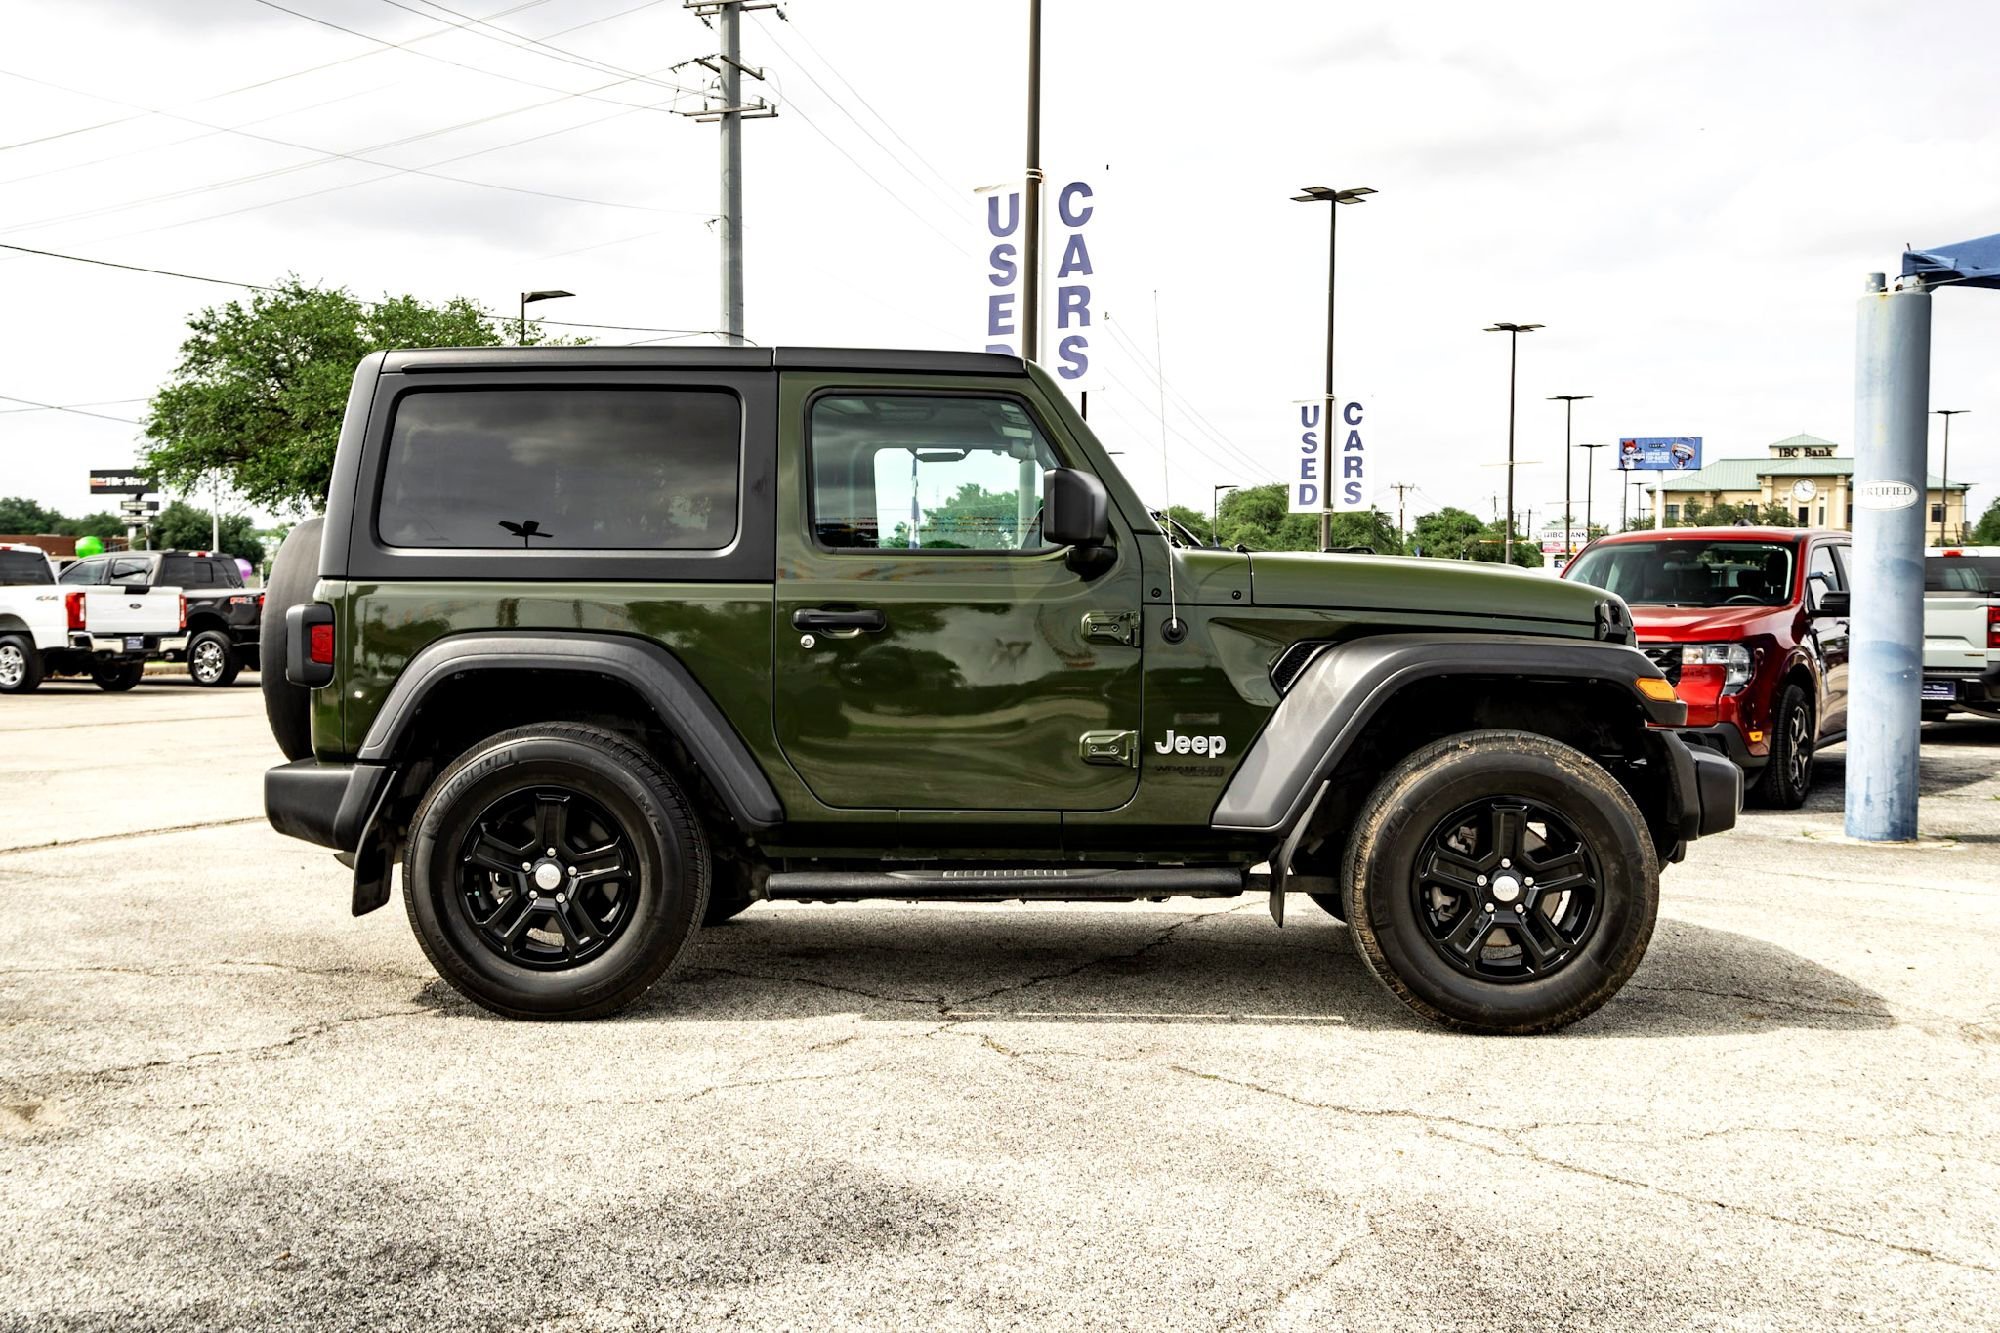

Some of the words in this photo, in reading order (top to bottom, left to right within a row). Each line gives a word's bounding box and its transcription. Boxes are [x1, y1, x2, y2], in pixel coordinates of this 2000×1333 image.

[985, 192, 1020, 355] USE
[1057, 181, 1094, 380] CARS
[1299, 405, 1320, 506] USED
[1343, 401, 1364, 505] CARS
[1778, 447, 1799, 458] IBC
[1804, 446, 1833, 458] Bank
[1154, 729, 1227, 759] Jeep
